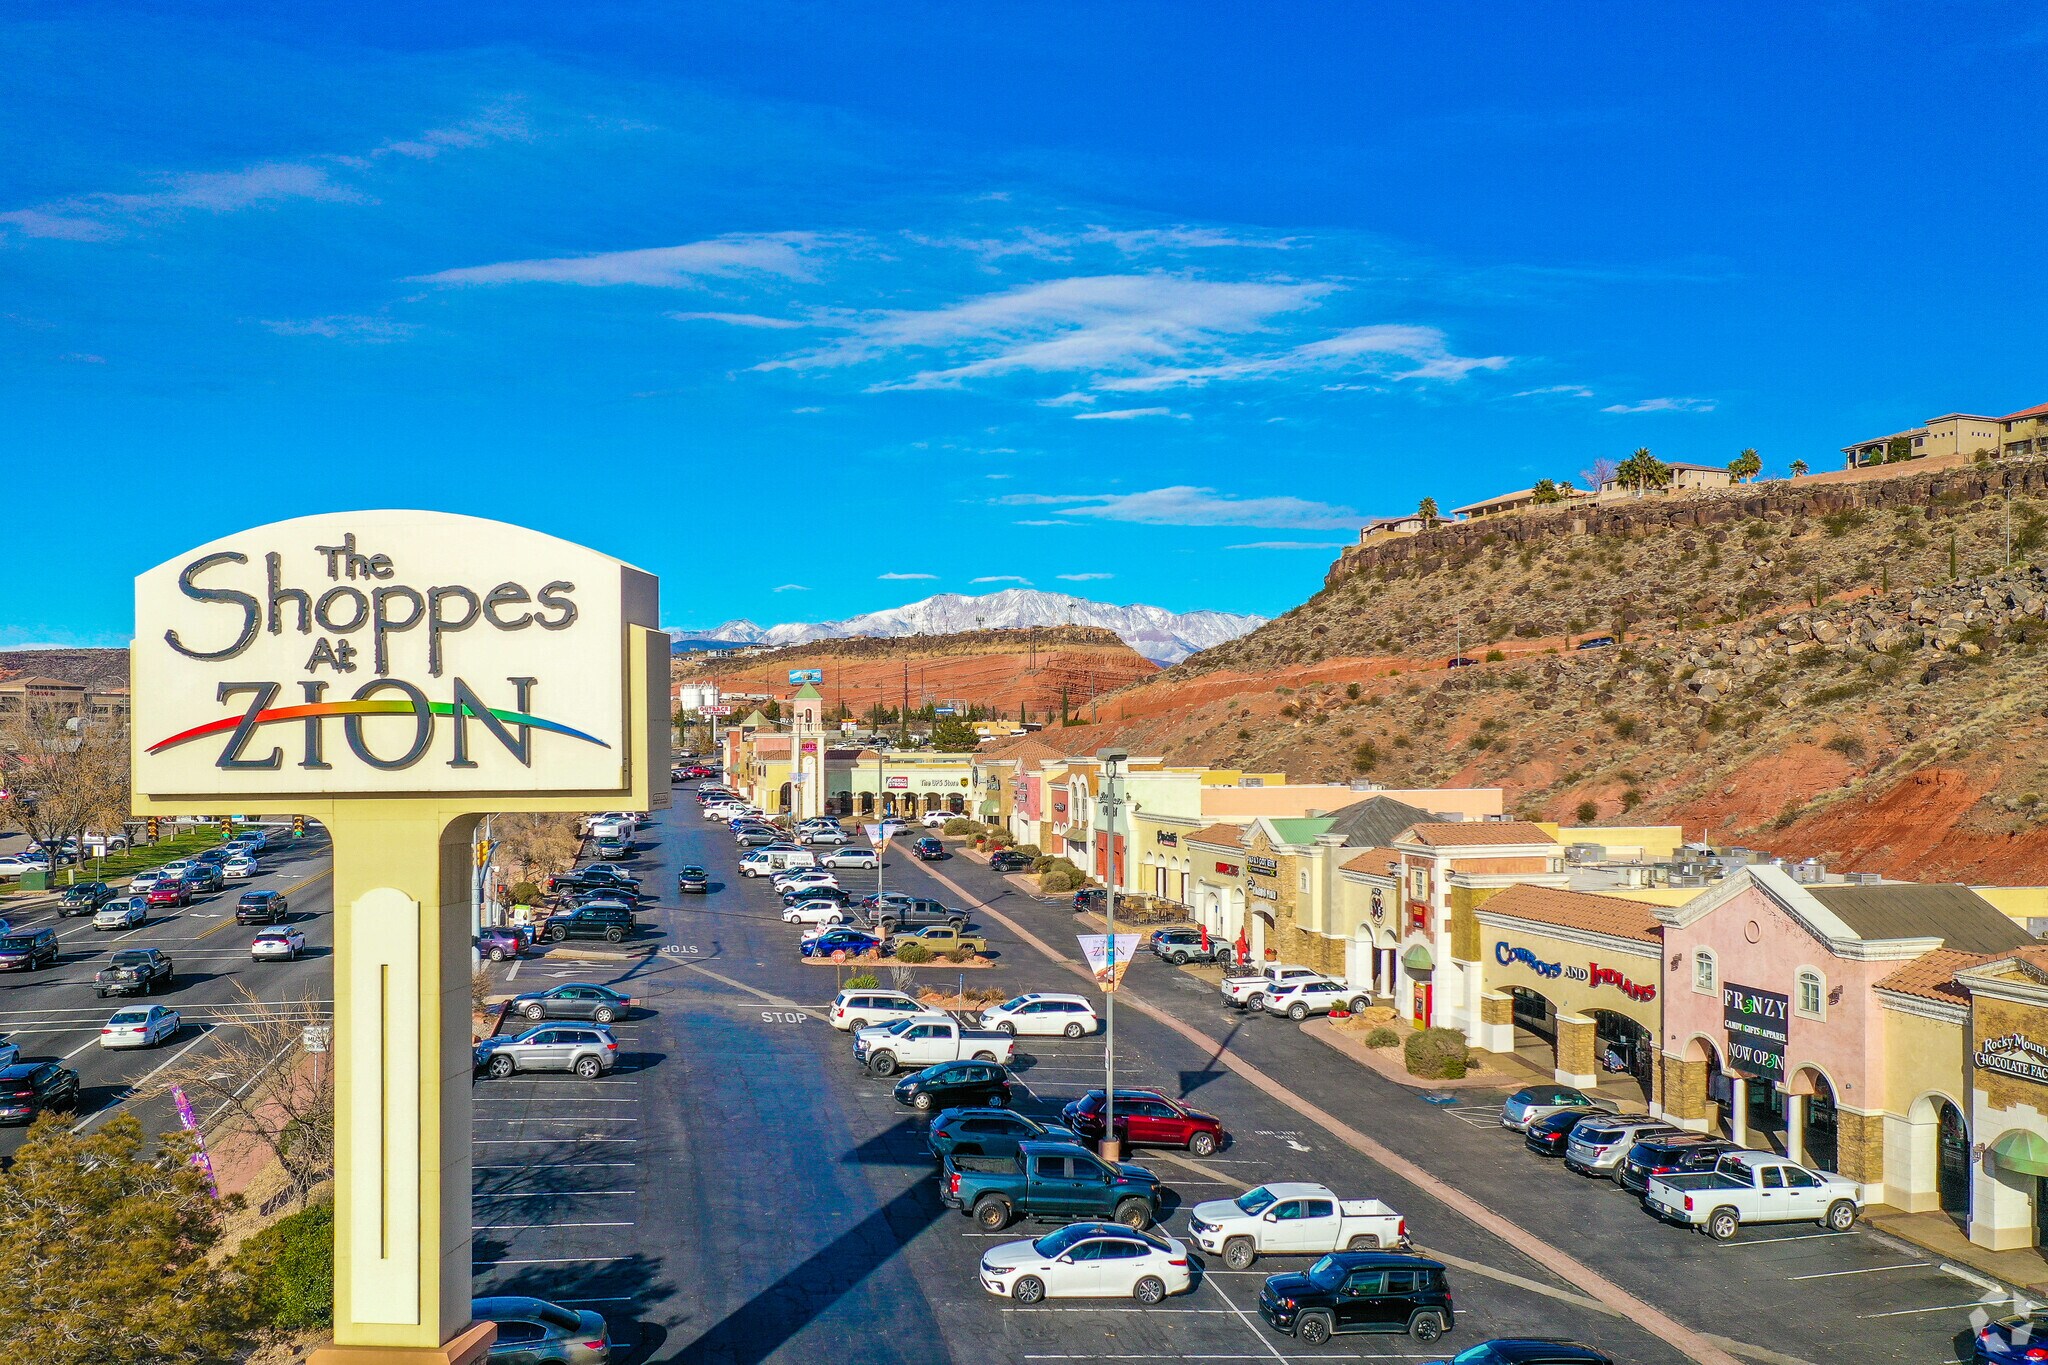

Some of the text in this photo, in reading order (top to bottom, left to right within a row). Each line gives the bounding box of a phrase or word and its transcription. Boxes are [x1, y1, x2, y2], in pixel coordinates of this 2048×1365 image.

[315, 532, 395, 581] The
[164, 551, 578, 677] Shoppes
[304, 637, 357, 673] At
[215, 677, 538, 770] ZION
[661, 944, 699, 954] STOP
[1564, 965, 1588, 981] AND
[761, 1011, 807, 1023] STOP
[1728, 1041, 1753, 1062] NOW
[1973, 1052, 2029, 1075] CHOCOLATE
